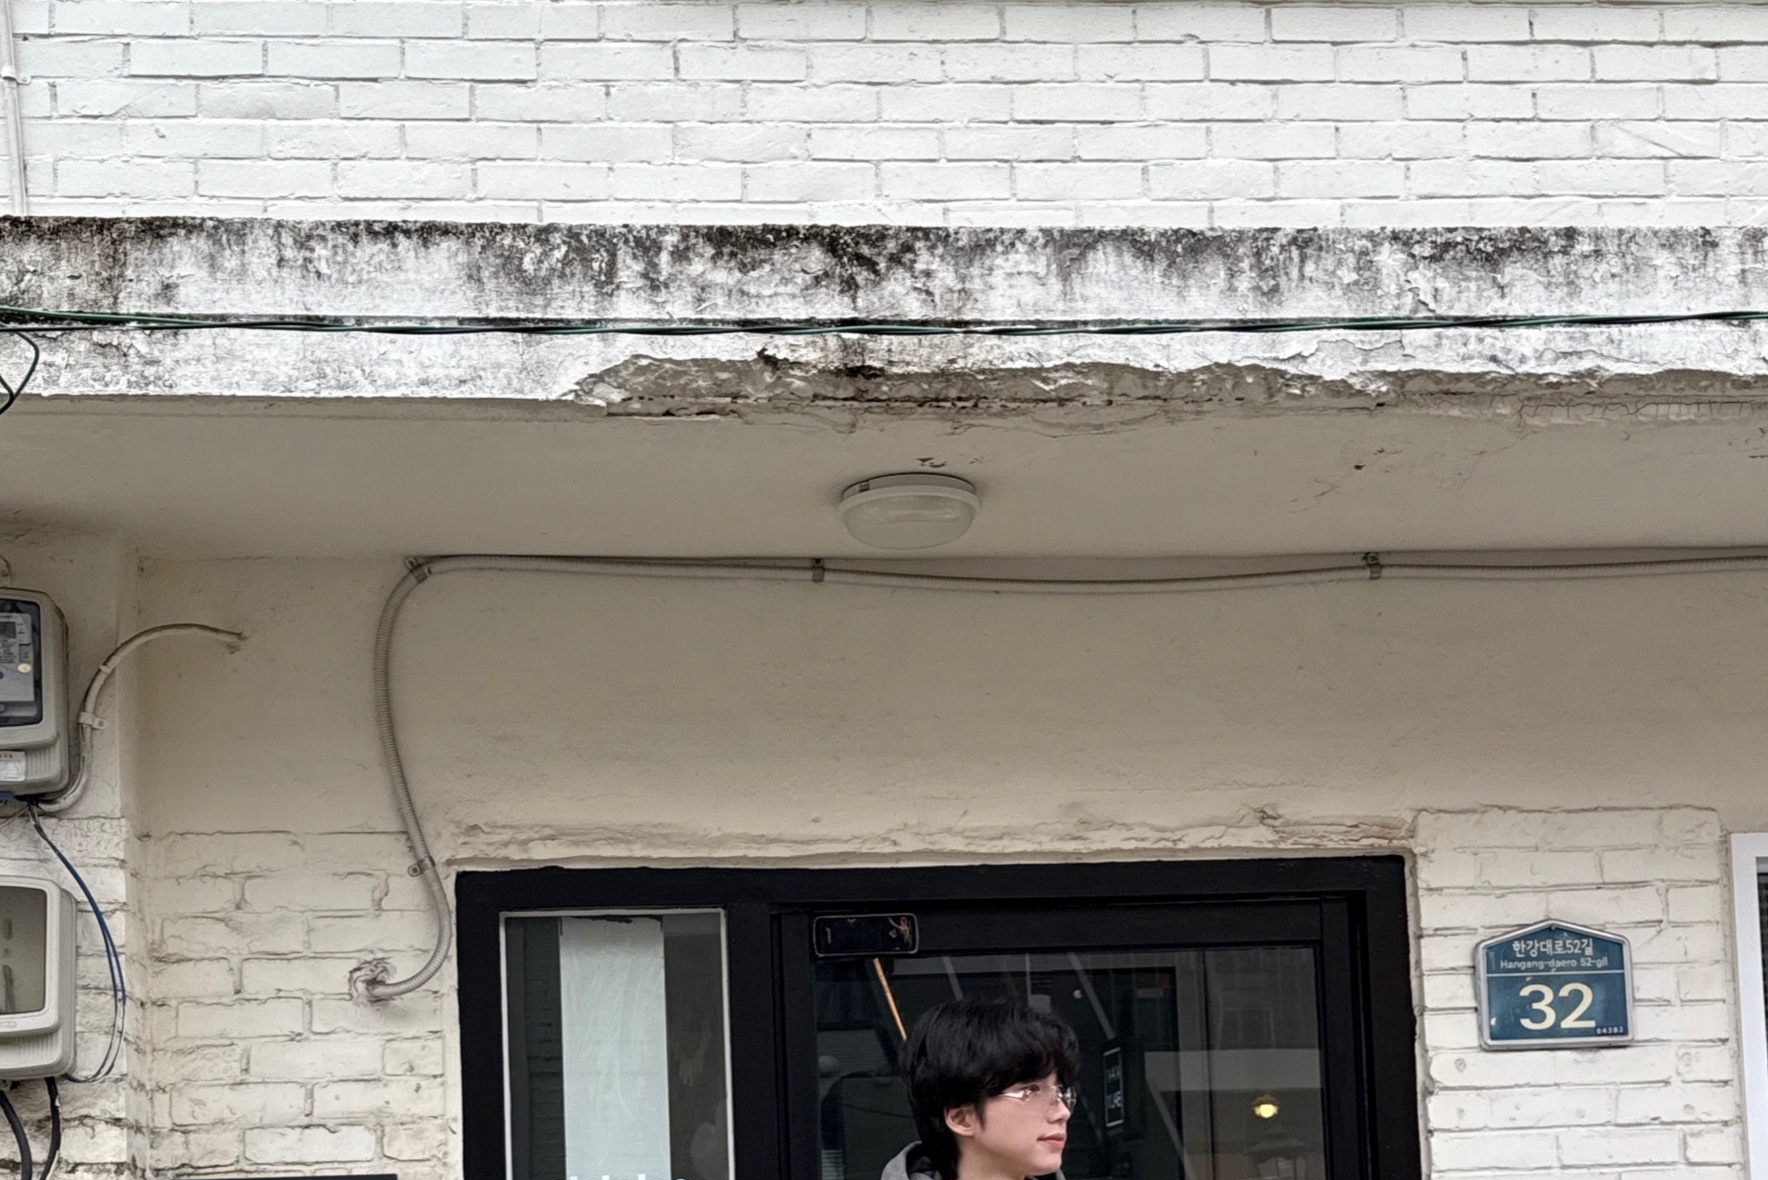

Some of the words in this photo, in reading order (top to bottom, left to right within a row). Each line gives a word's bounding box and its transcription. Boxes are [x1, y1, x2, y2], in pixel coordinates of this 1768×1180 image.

[1512, 938, 1593, 958] 한강대로52길
[1500, 959, 1577, 970] Hangang-daero
[1580, 957, 1608, 969] 52-gil
[1519, 982, 1596, 1030] 32
